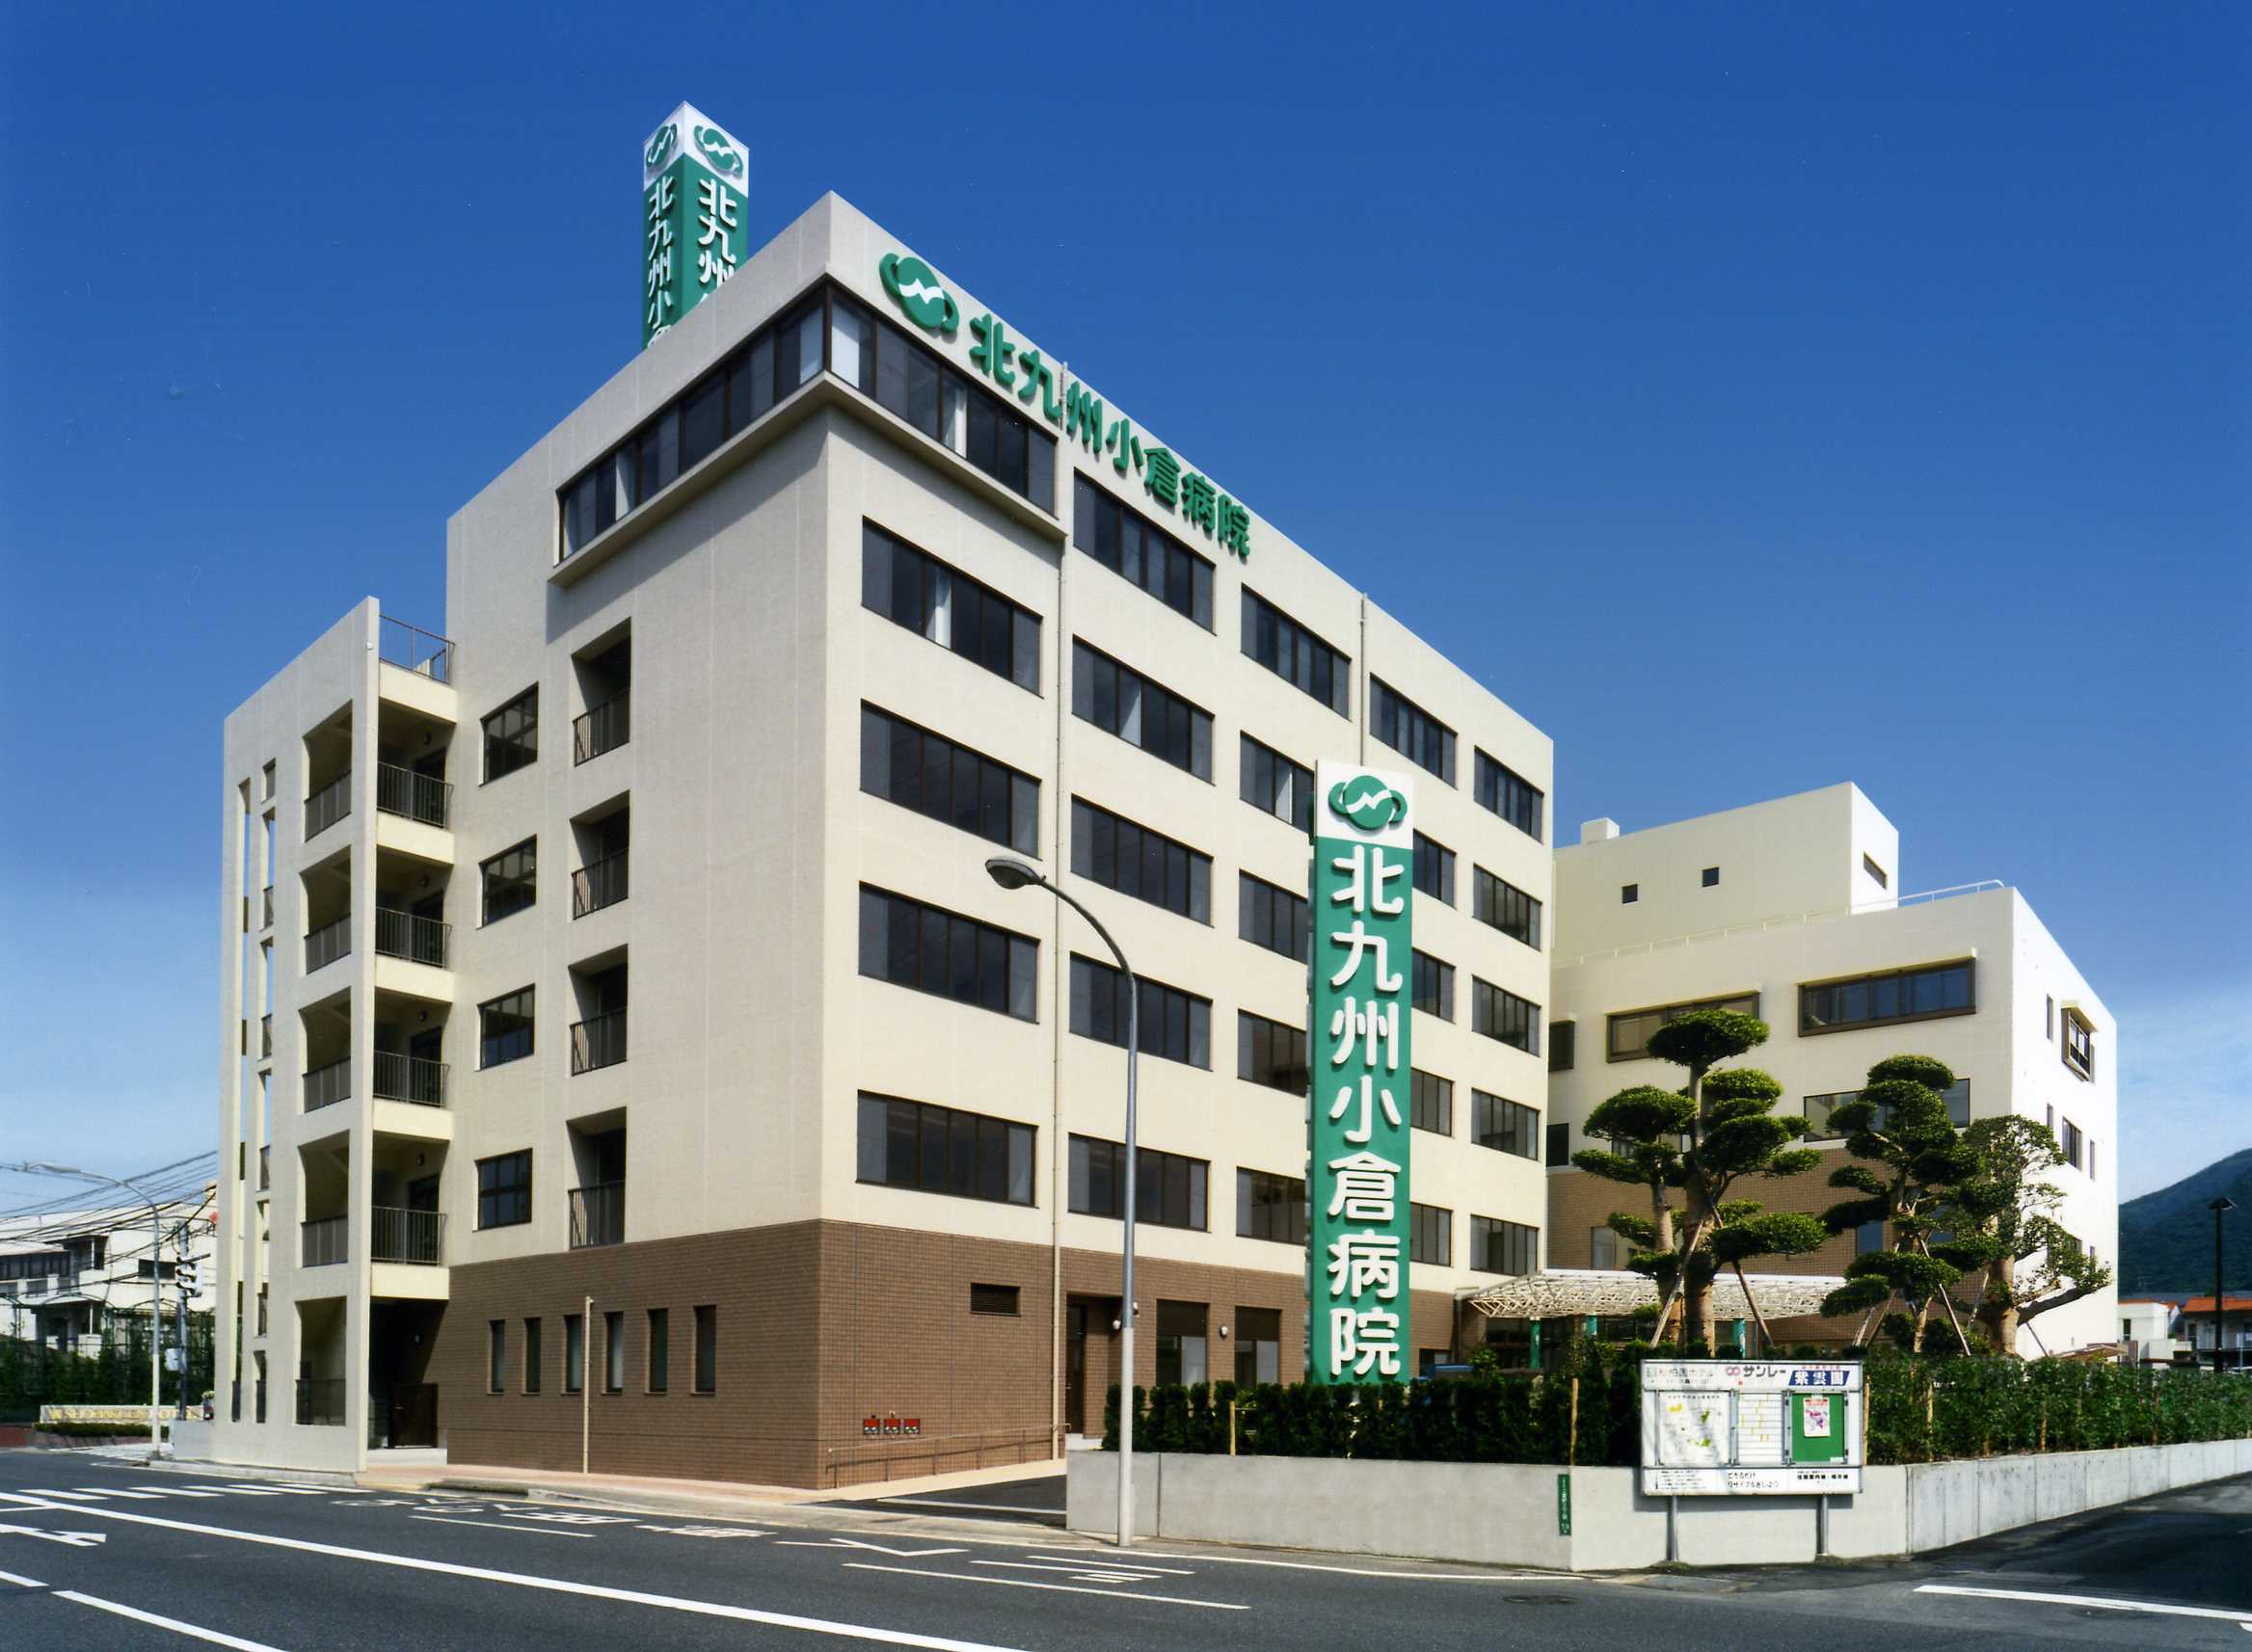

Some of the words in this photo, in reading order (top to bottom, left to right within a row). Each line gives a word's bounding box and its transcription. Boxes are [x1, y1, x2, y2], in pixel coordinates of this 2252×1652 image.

[698, 178, 737, 303] 北九州
[969, 313, 1250, 557] 北九州小倉病院
[1327, 844, 1405, 1378] 北九州小倉病院
[1743, 1365, 1786, 1377] サンレー
